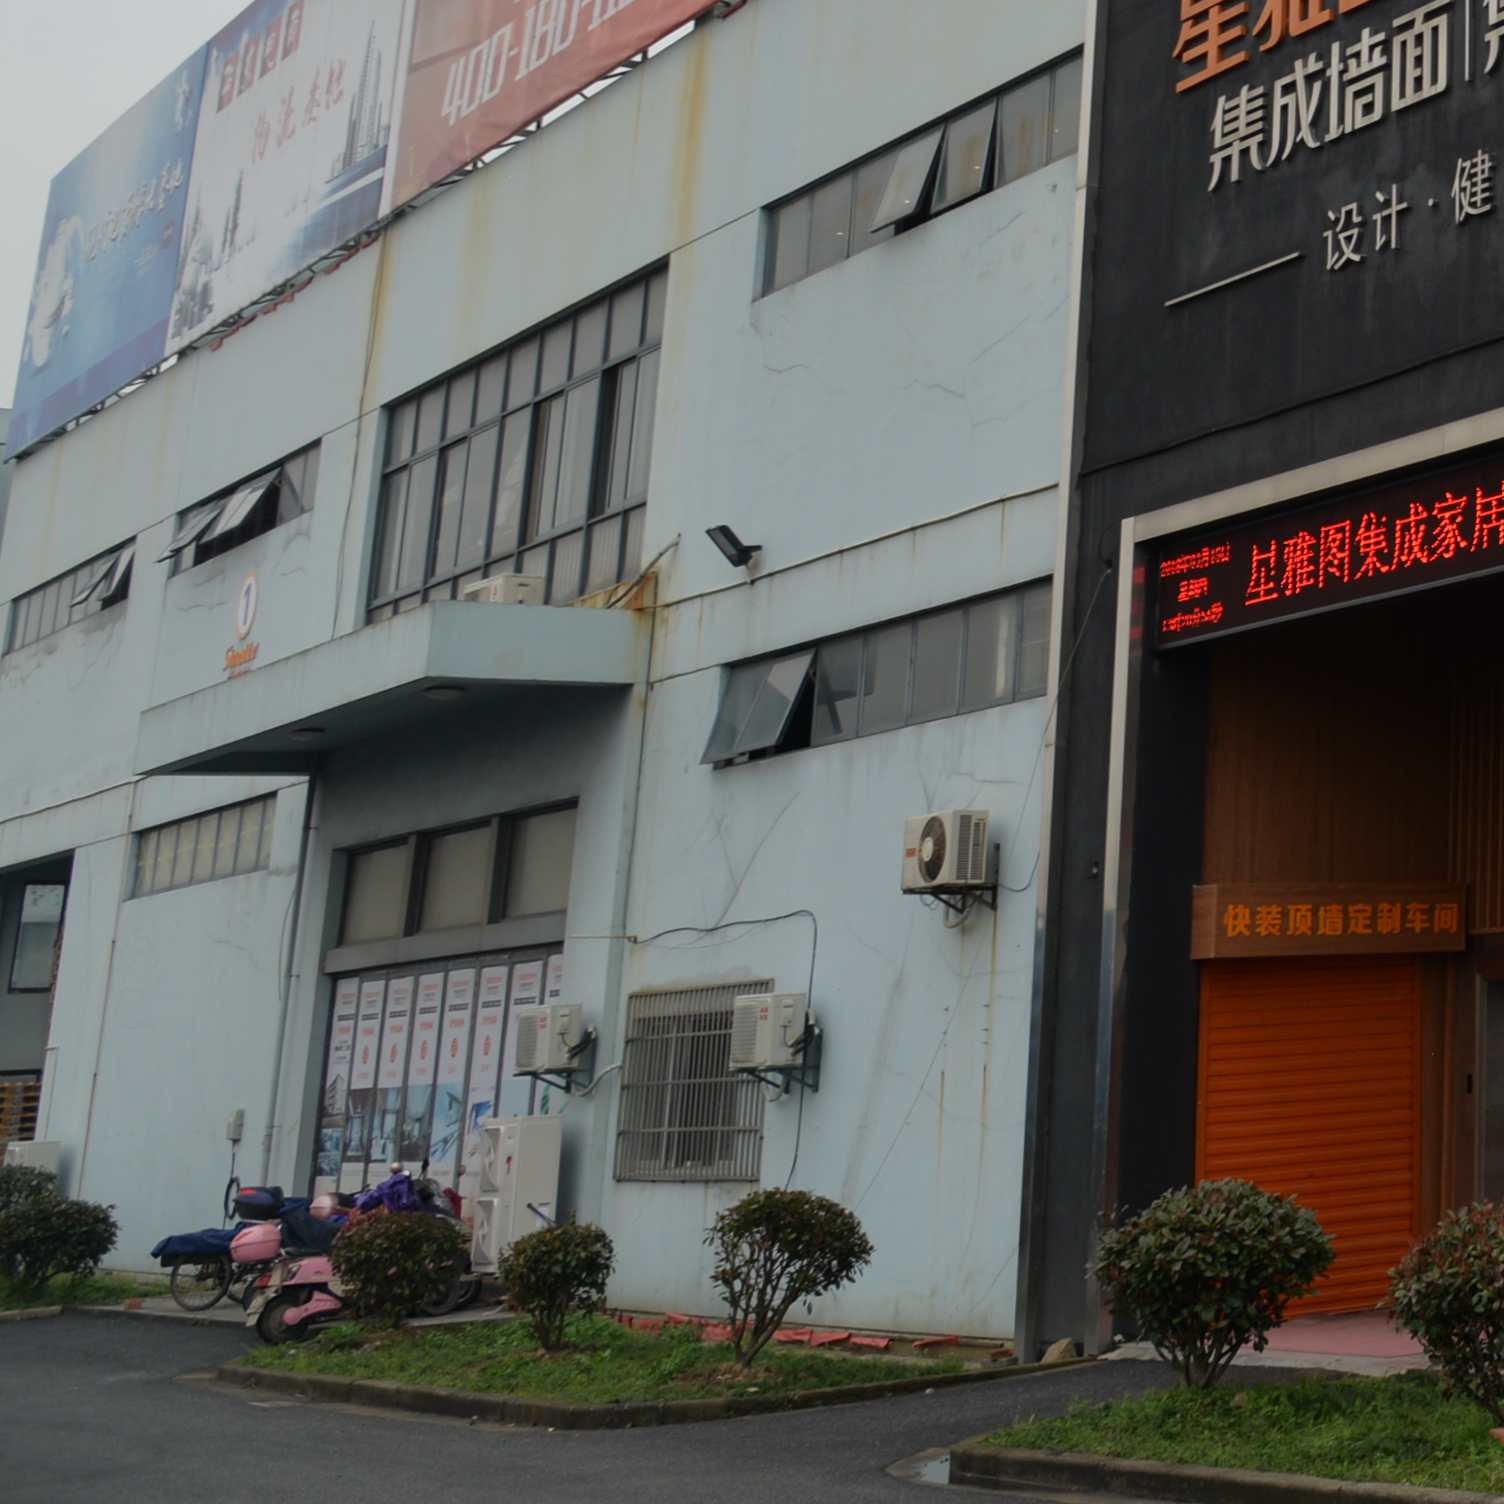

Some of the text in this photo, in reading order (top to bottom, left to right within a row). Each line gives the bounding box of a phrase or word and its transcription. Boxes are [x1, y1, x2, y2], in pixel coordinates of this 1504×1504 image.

[1224, 902, 1459, 937] 快装顶墙定制车间
